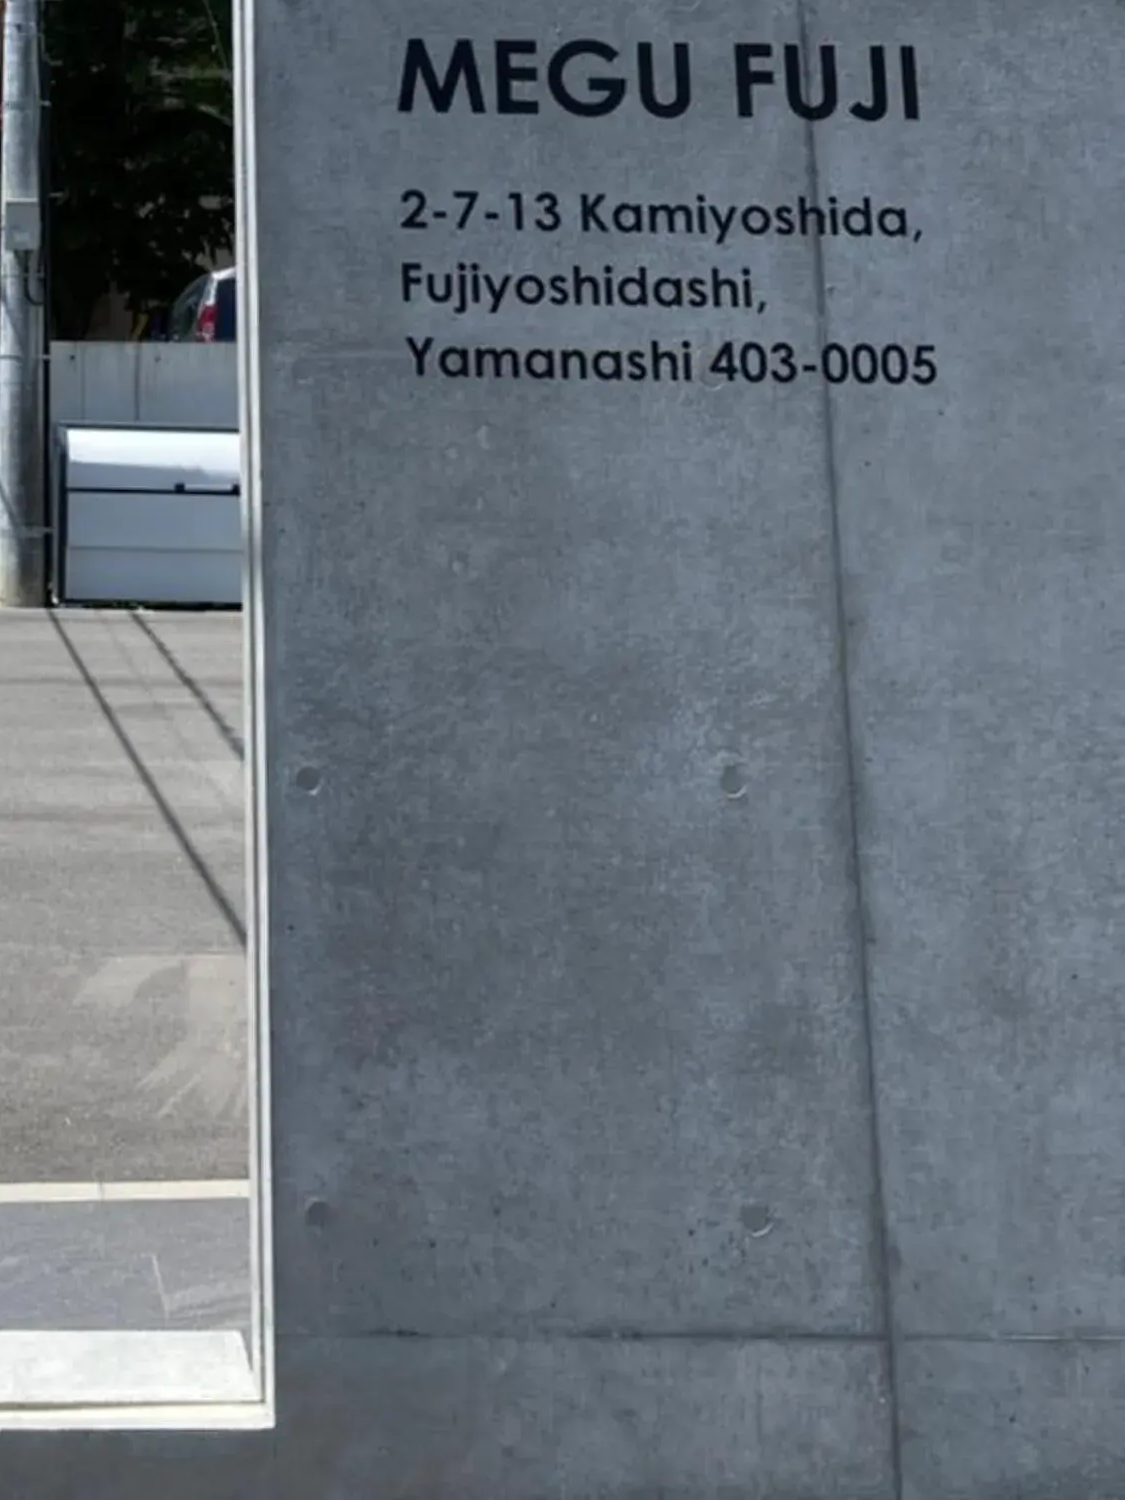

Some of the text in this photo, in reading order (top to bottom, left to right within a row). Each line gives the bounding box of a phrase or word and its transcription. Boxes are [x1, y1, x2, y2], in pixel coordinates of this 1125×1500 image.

[397, 38, 921, 122] MEGU FUJI
[399, 189, 923, 243] 2-7-13 Kamiyoshida,
[401, 262, 767, 314] Fujiyoshidashi,
[405, 336, 938, 385] Yamanashi 403-0005
